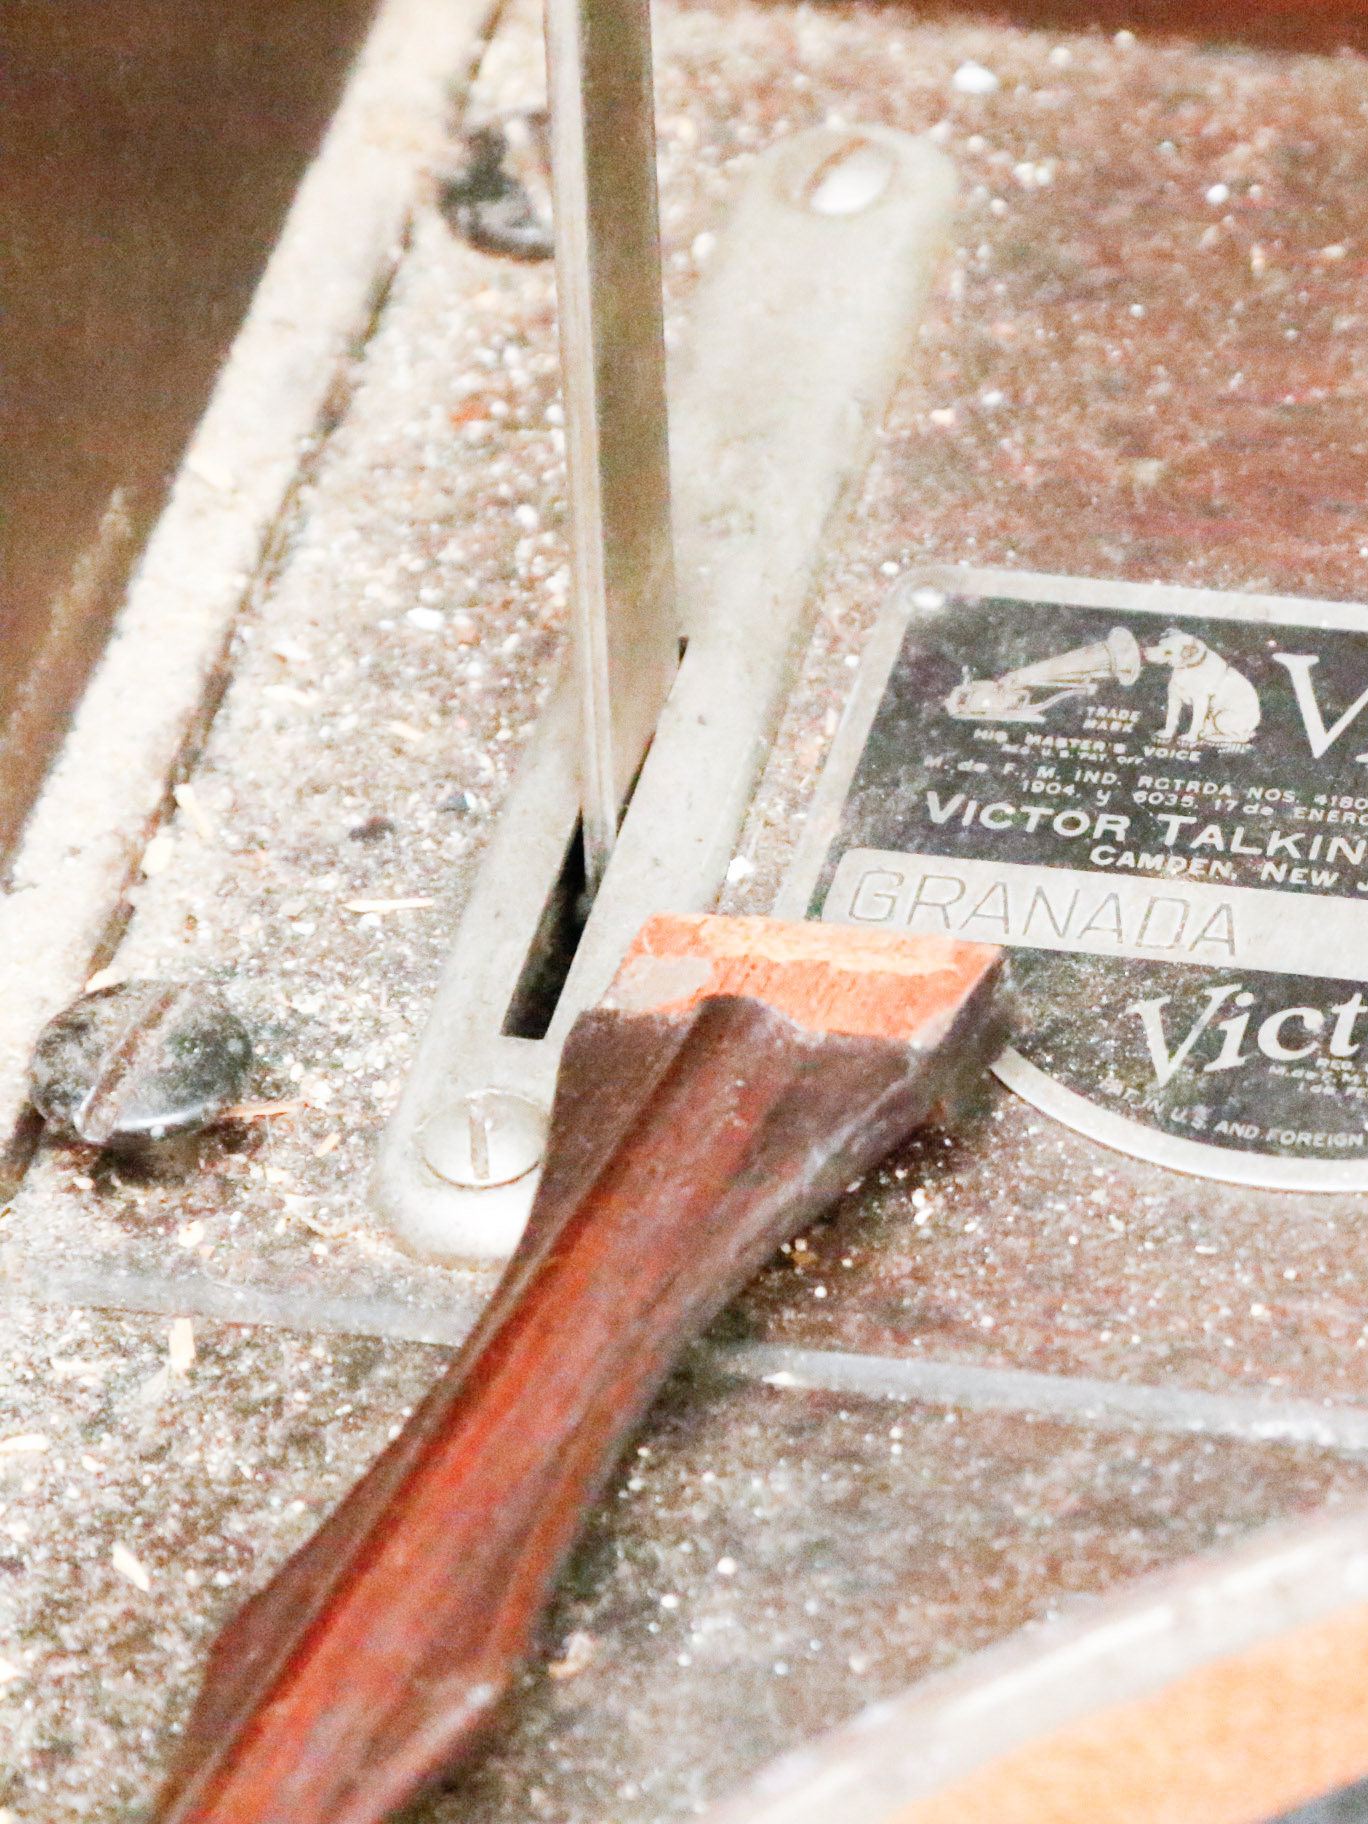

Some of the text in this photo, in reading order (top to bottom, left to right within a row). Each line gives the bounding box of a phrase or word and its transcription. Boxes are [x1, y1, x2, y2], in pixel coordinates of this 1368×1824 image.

[1086, 706, 1141, 723] TRADE
[1144, 746, 1201, 762] VOICE
[1075, 769, 1122, 786] IND.
[1137, 775, 1233, 797] RGTRDA
[1247, 786, 1300, 803] NOS.
[926, 791, 1131, 842] VICTOR
[1096, 789, 1112, 807] y
[1214, 799, 1239, 812] 17
[1243, 803, 1275, 816] de
[1090, 845, 1238, 881] CAMDEN,
[1260, 861, 1340, 887] NEW
[847, 868, 1237, 957] GRANADA
[1214, 1120, 1260, 1140] AND
[1266, 1127, 1364, 1147] FOREIGN
